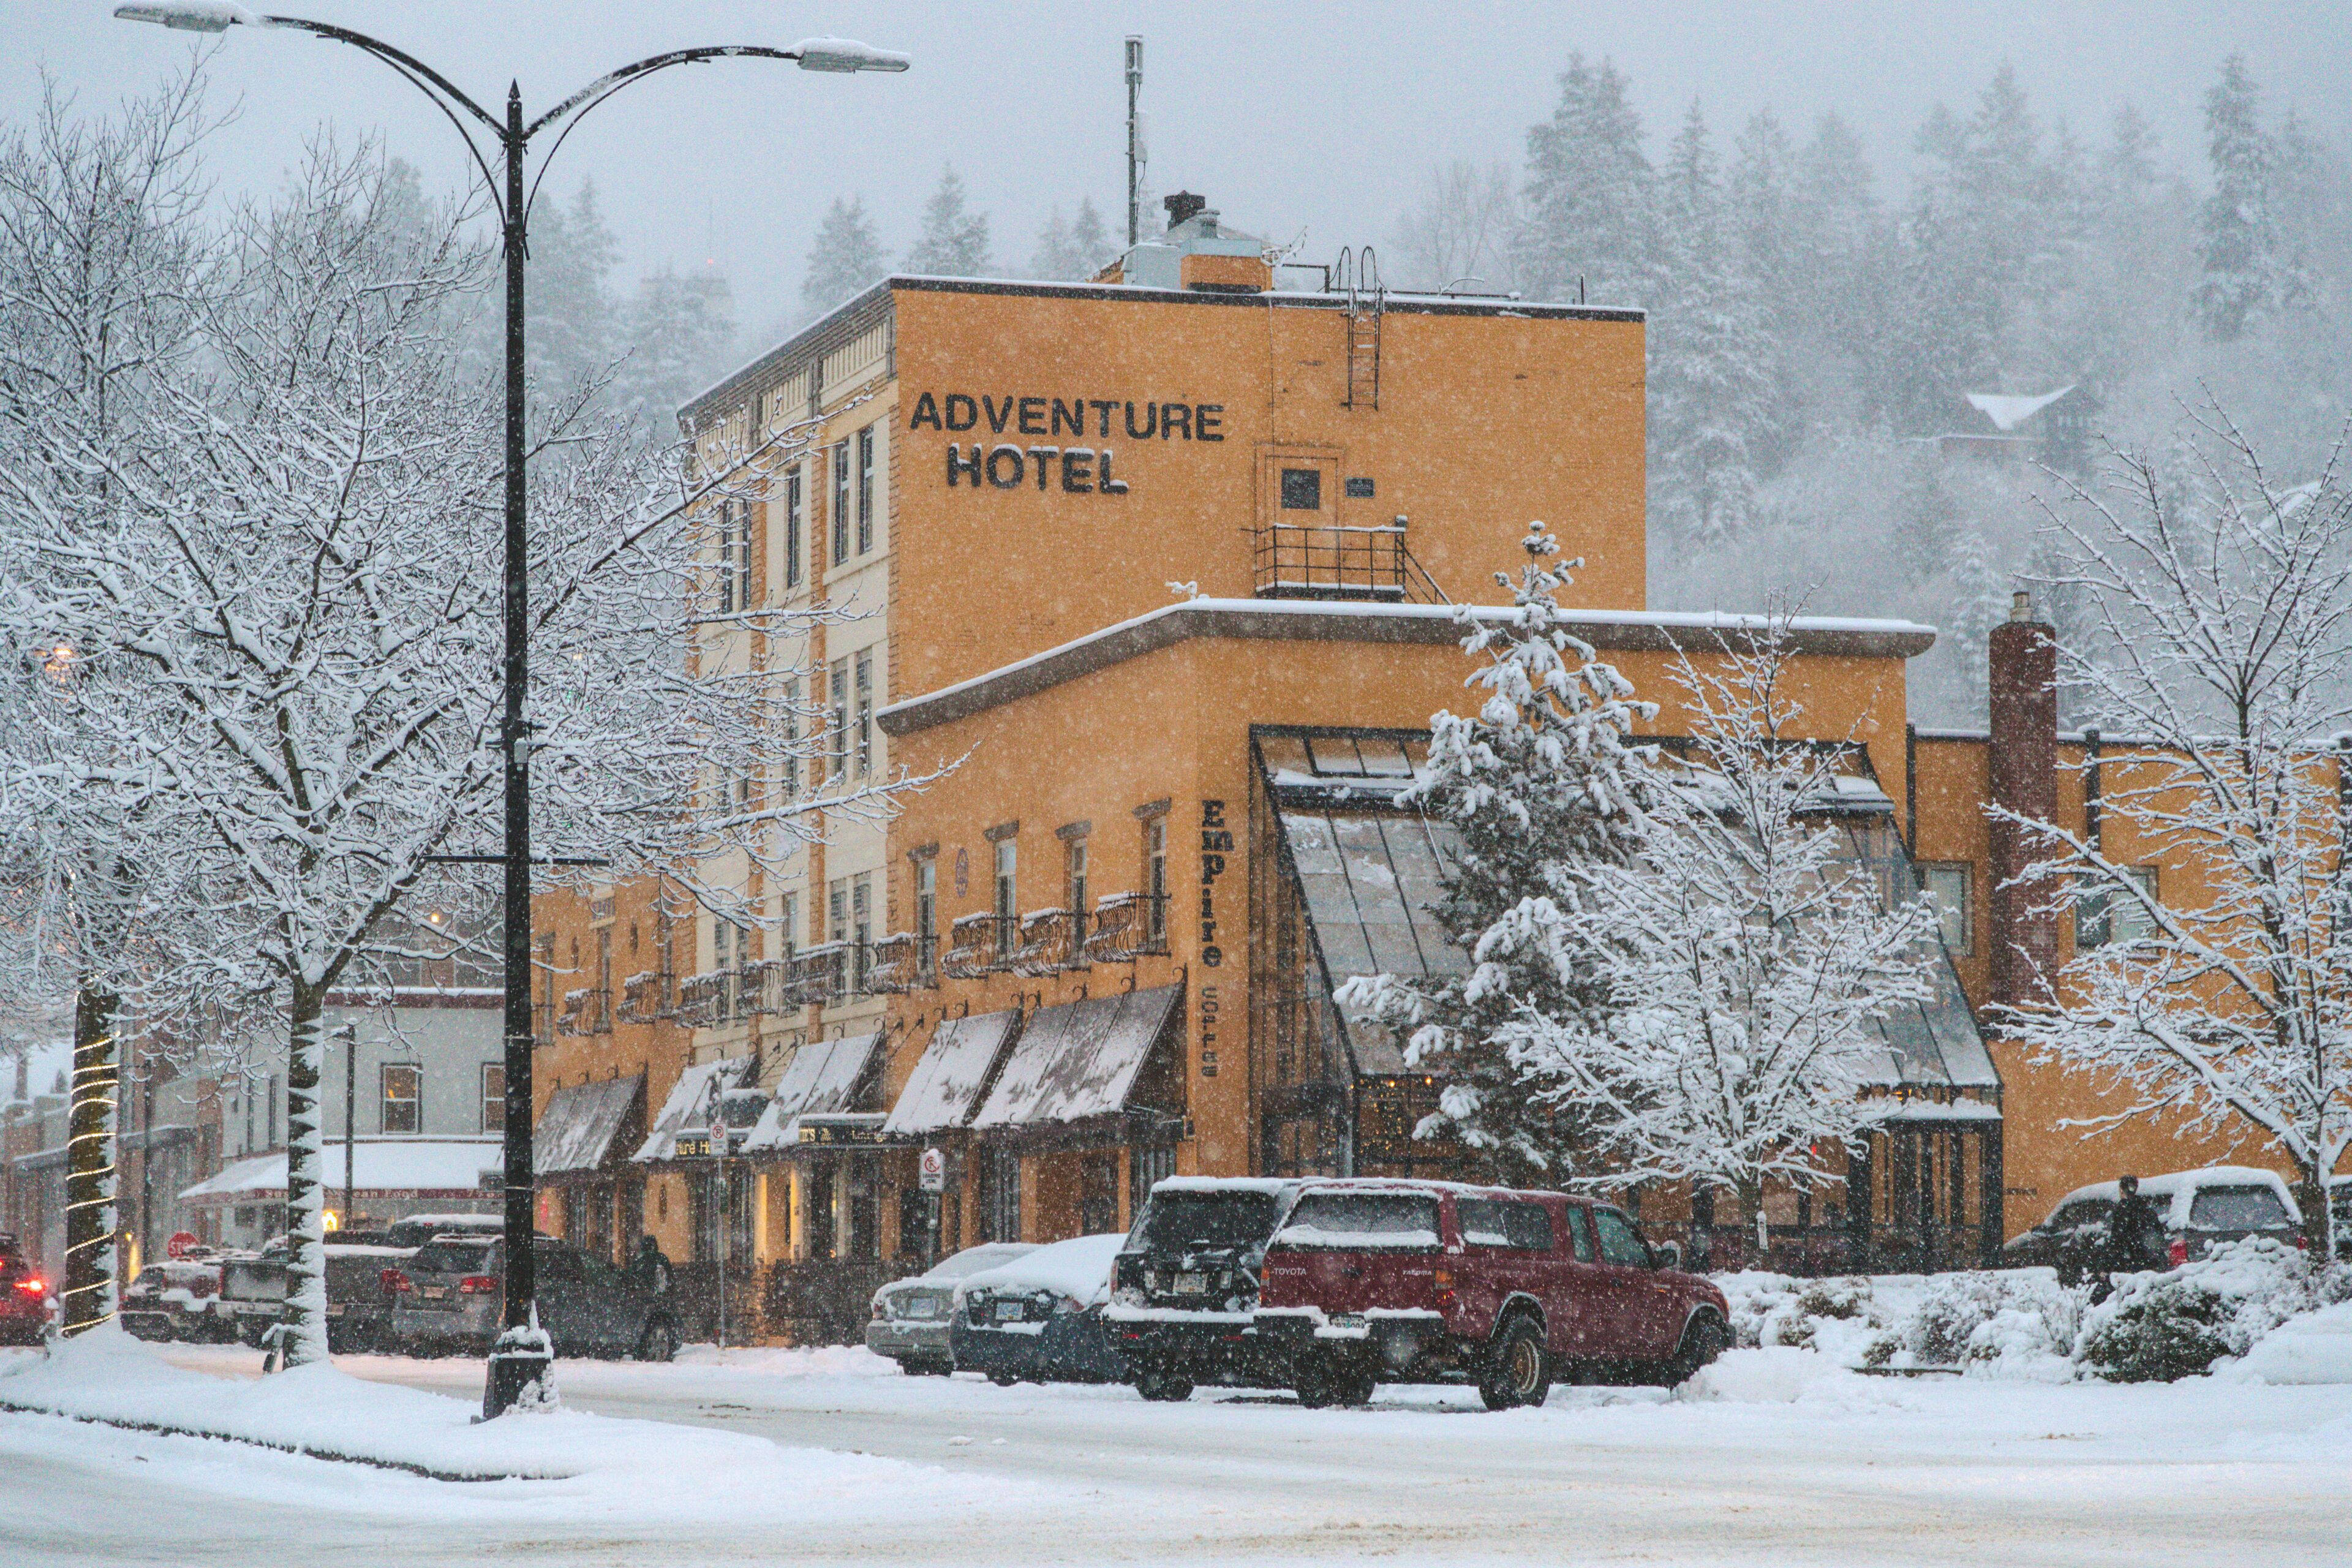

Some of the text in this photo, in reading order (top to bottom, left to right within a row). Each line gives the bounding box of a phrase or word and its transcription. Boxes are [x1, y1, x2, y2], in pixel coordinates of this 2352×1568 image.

[910, 392, 1225, 442] ADVENTURE
[947, 444, 1129, 494] HOTEL
[1202, 799, 1234, 968] Empire
[1273, 1267, 1307, 1276] TOYOTA
